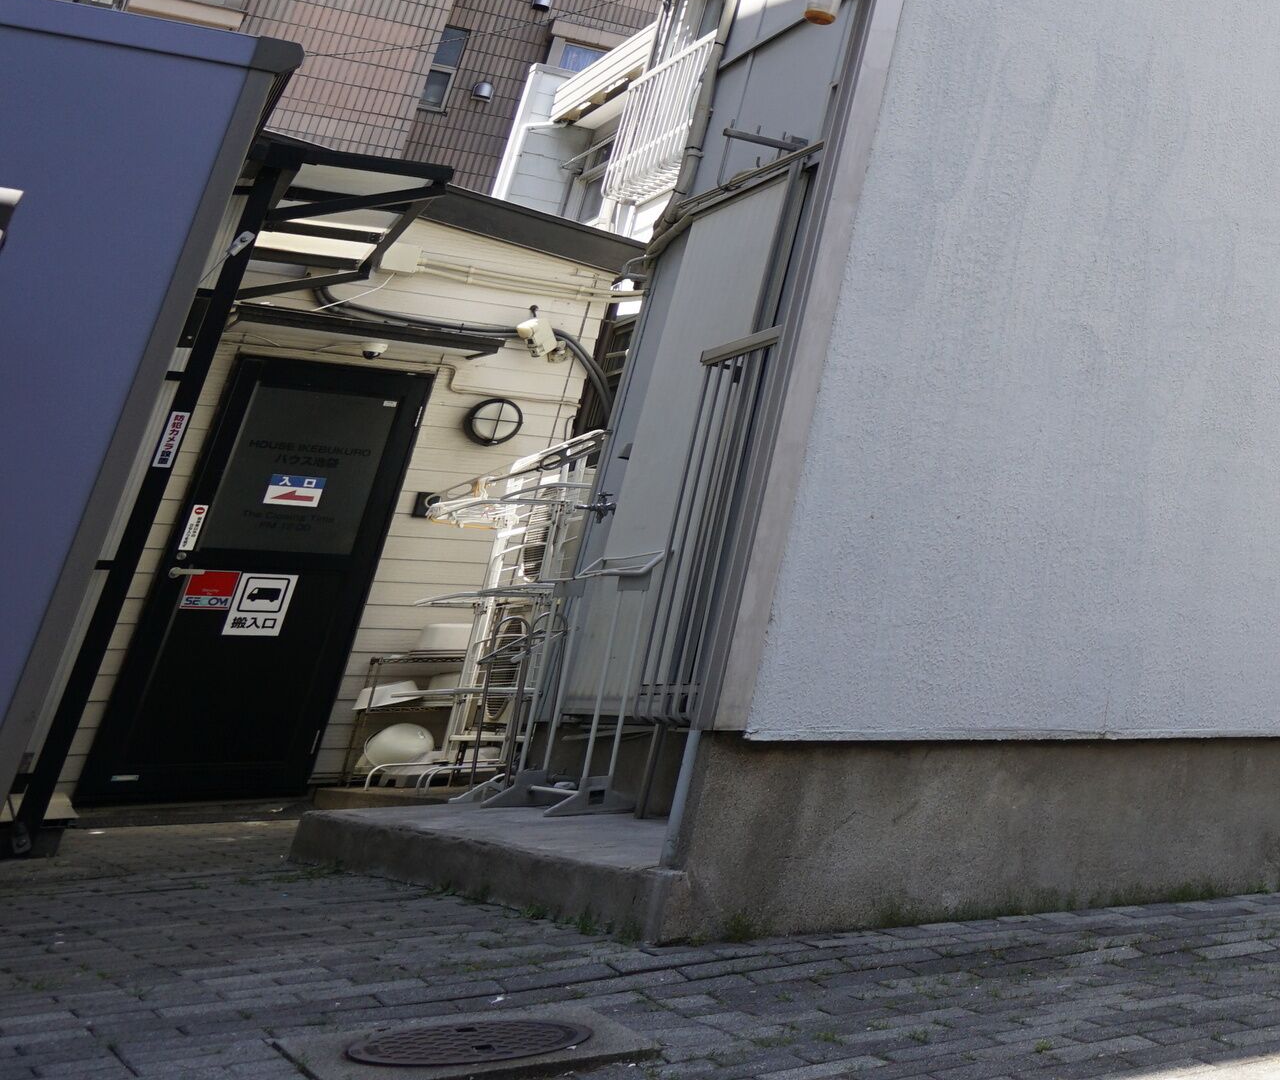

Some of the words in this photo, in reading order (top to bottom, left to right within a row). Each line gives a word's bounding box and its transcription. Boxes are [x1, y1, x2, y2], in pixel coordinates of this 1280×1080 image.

[278, 476, 317, 488] 入口
[230, 616, 277, 629] 搬入口
